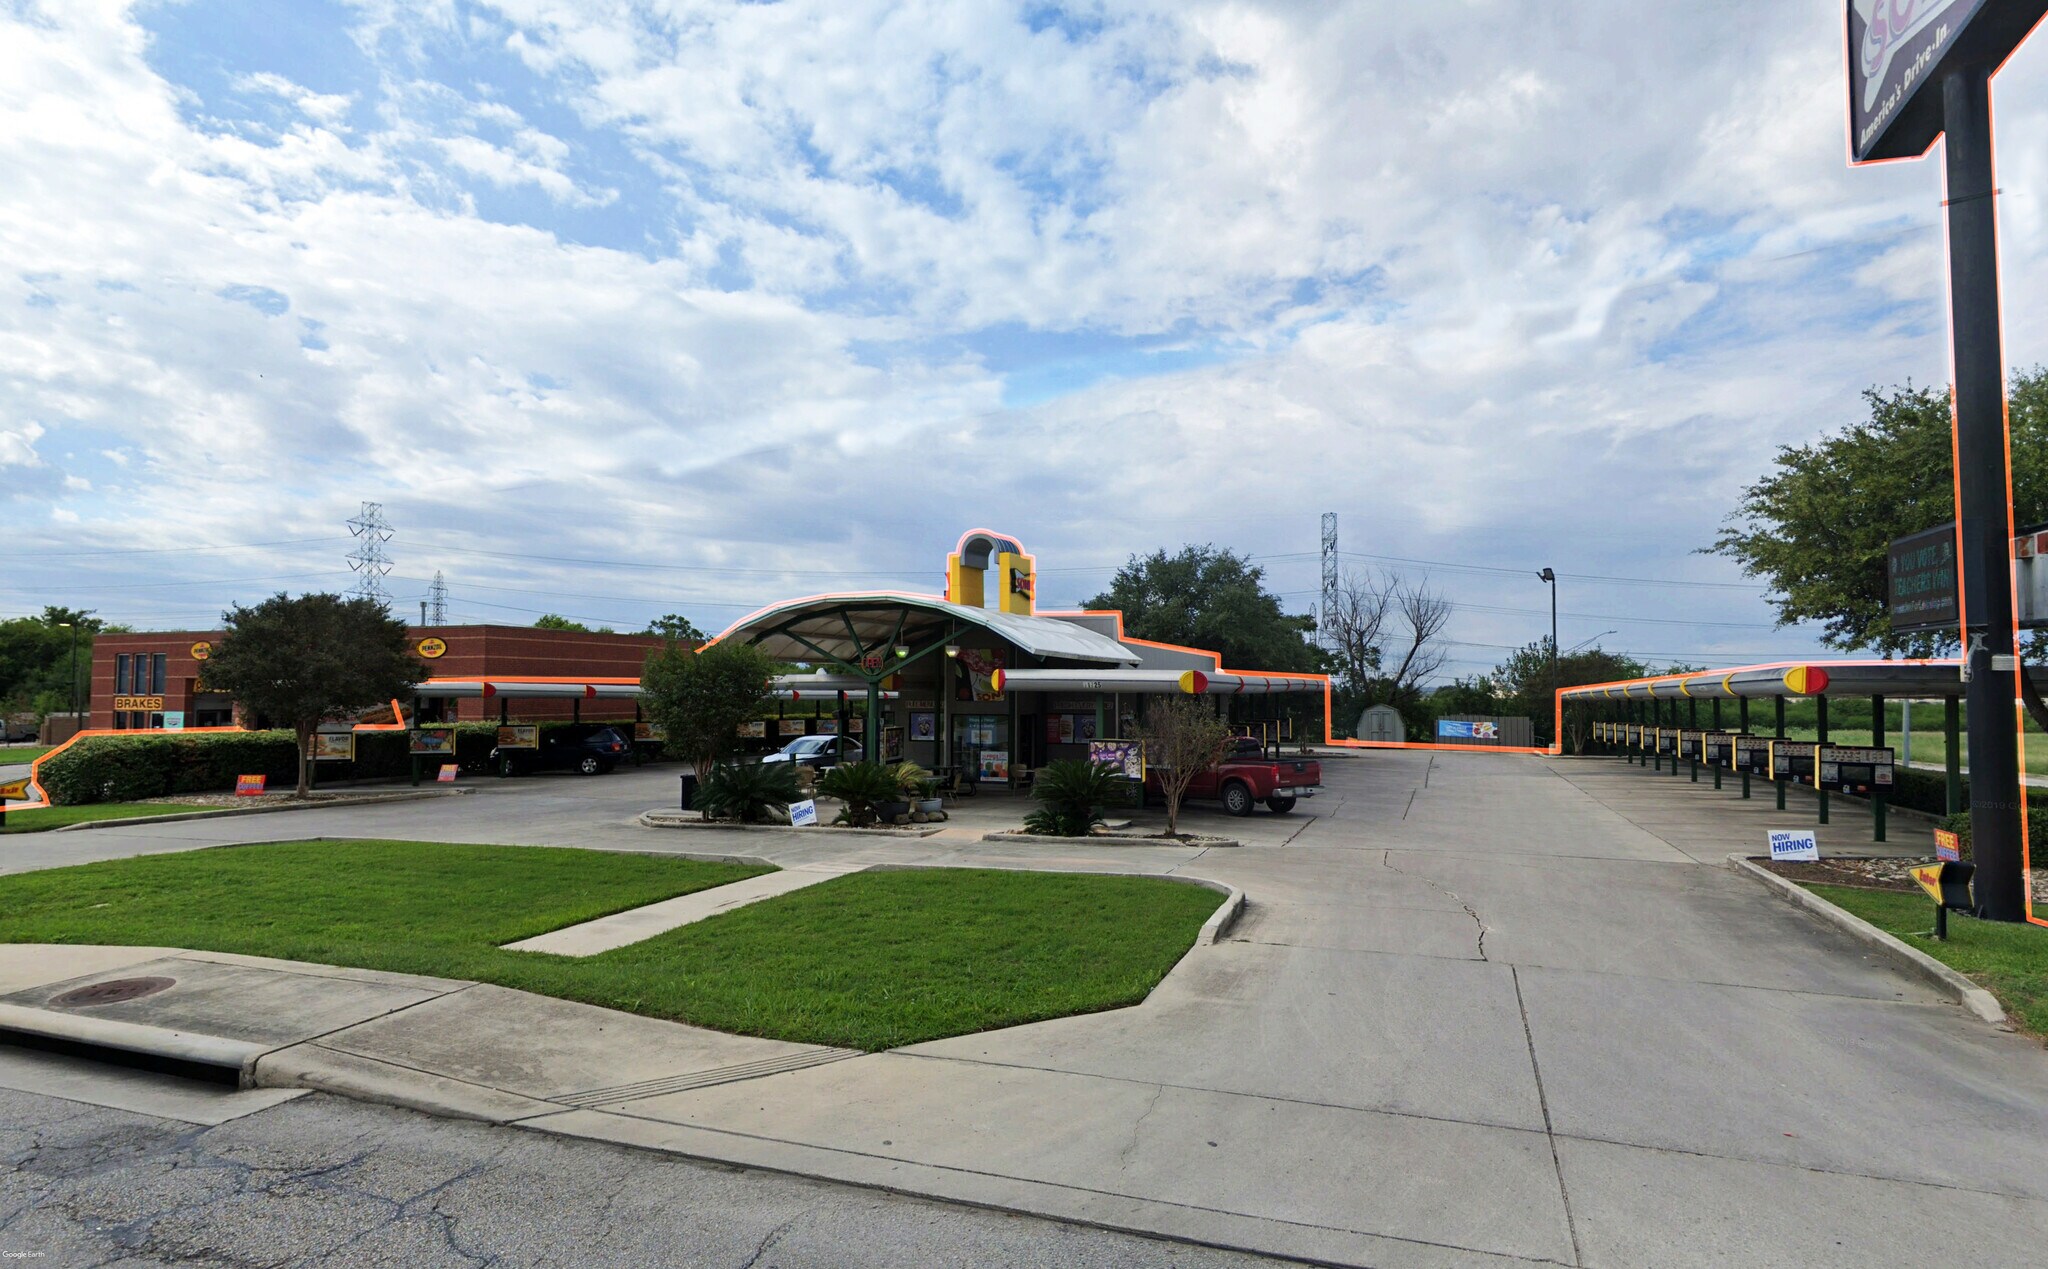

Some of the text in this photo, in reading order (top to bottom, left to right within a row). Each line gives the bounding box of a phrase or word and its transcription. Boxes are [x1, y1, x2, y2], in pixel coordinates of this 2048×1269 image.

[1860, 23, 1948, 148] America's Drive-In
[117, 699, 161, 709] BRAKES
[241, 775, 262, 784] FREE
[792, 805, 814, 821] HIRING
[1771, 833, 1790, 841] NOW
[1936, 831, 1956, 850] FREE
[1772, 838, 1814, 852] HIRING
